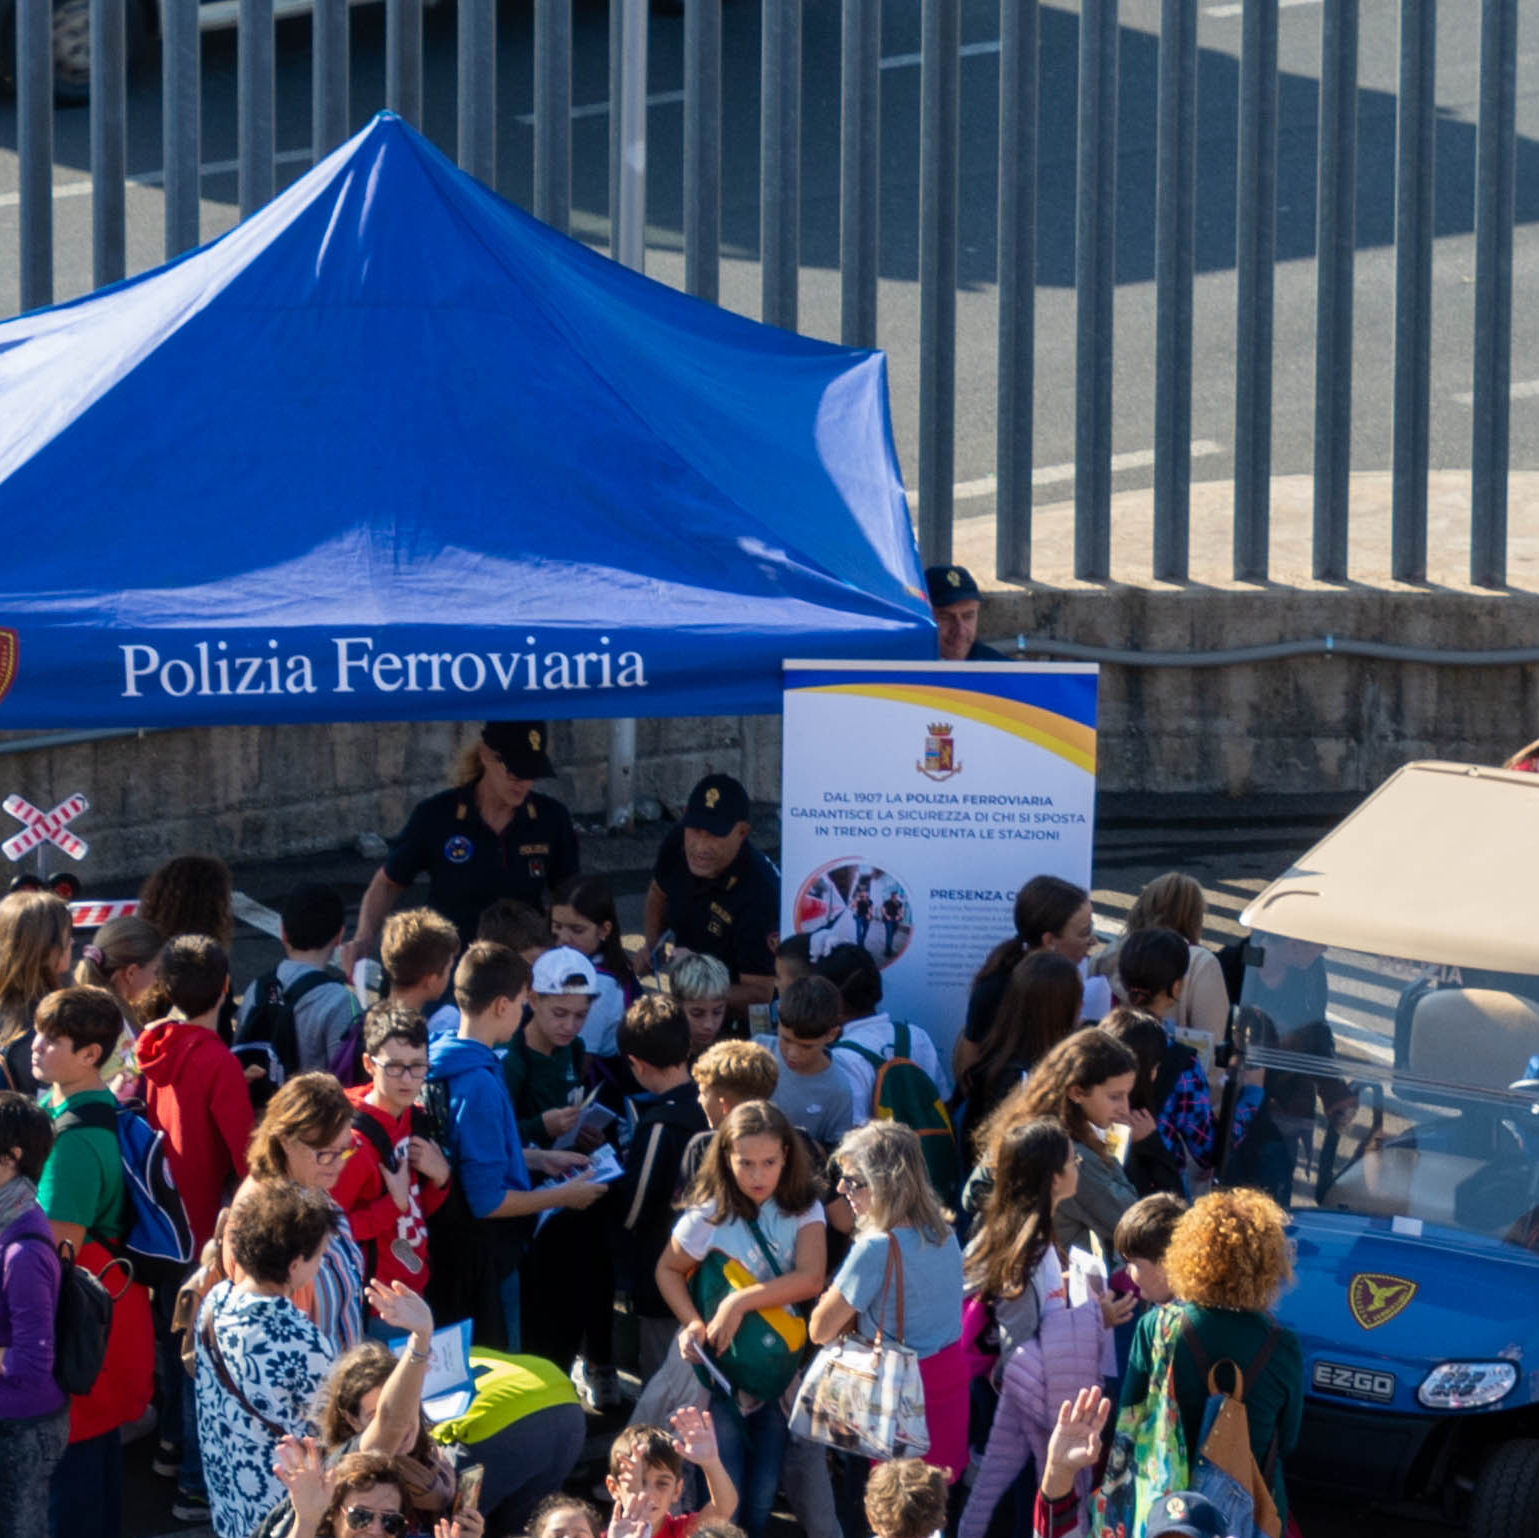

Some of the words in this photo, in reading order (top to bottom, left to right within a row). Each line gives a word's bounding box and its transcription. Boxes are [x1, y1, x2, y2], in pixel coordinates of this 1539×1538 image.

[118, 639, 317, 698] Polizia
[330, 635, 648, 693] Ferroviaria
[823, 791, 850, 803] DAL
[854, 791, 882, 803] 1907
[886, 792, 902, 804] LA
[906, 793, 959, 805] POLIZIA
[962, 794, 1053, 807] FERROVIARIA
[790, 807, 874, 821] GARANTISCE
[877, 809, 894, 821] LA
[898, 809, 971, 822] SICUREZZA
[974, 811, 989, 822] DI
[992, 812, 1015, 823] CHI
[1019, 812, 1031, 823] SI
[1033, 812, 1086, 825] SPOSTA
[815, 826, 829, 837] IN
[832, 826, 878, 838] TRENO
[881, 827, 892, 838] O
[895, 827, 976, 840] FREQUENTA
[979, 829, 995, 840] LE
[998, 829, 1060, 841] STAZIONI
[929, 889, 1003, 901] PRESENZA
